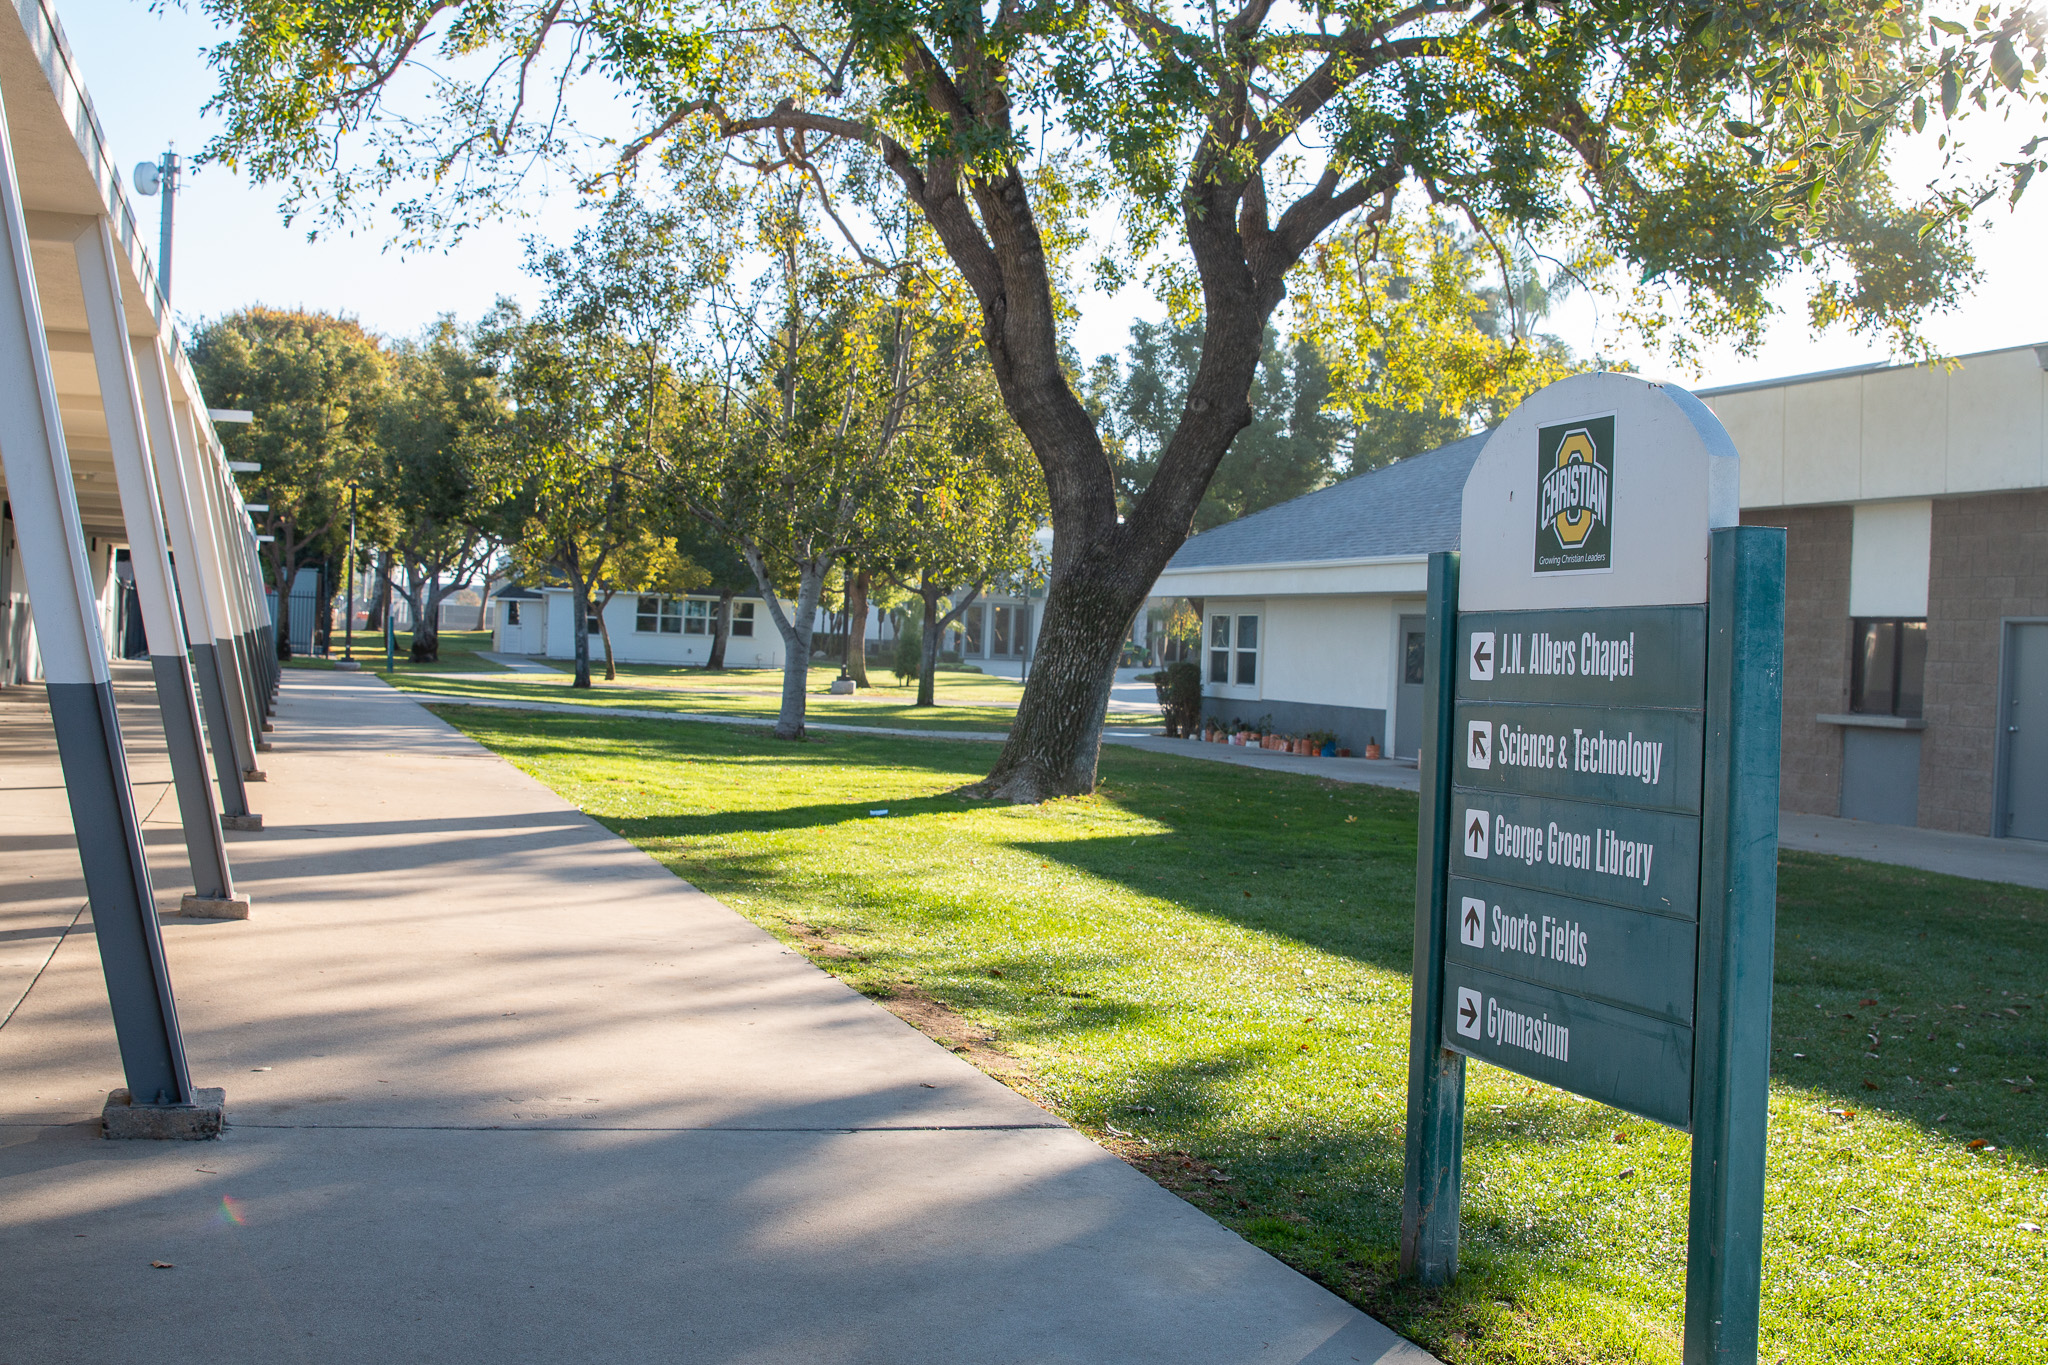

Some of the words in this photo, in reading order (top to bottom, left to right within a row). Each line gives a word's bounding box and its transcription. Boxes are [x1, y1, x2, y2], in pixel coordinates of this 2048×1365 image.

[1541, 465, 1608, 531] CHRISTIAN
[1539, 555, 1561, 566] Growing
[1561, 554, 1584, 563] Christian
[1585, 553, 1605, 562] Leaders
[1500, 633, 1524, 674] J.N.
[1528, 632, 1576, 675] Albers
[1580, 632, 1634, 681] Chapel
[1498, 724, 1554, 768] Science
[1558, 735, 1568, 769] &
[1573, 728, 1662, 784] Technology
[1495, 815, 1543, 866] George
[1547, 821, 1591, 870] Groen
[1595, 828, 1653, 886] Library
[1491, 905, 1537, 955] Sports
[1541, 915, 1588, 966] Fields
[1487, 997, 1569, 1063] Gymnasium
